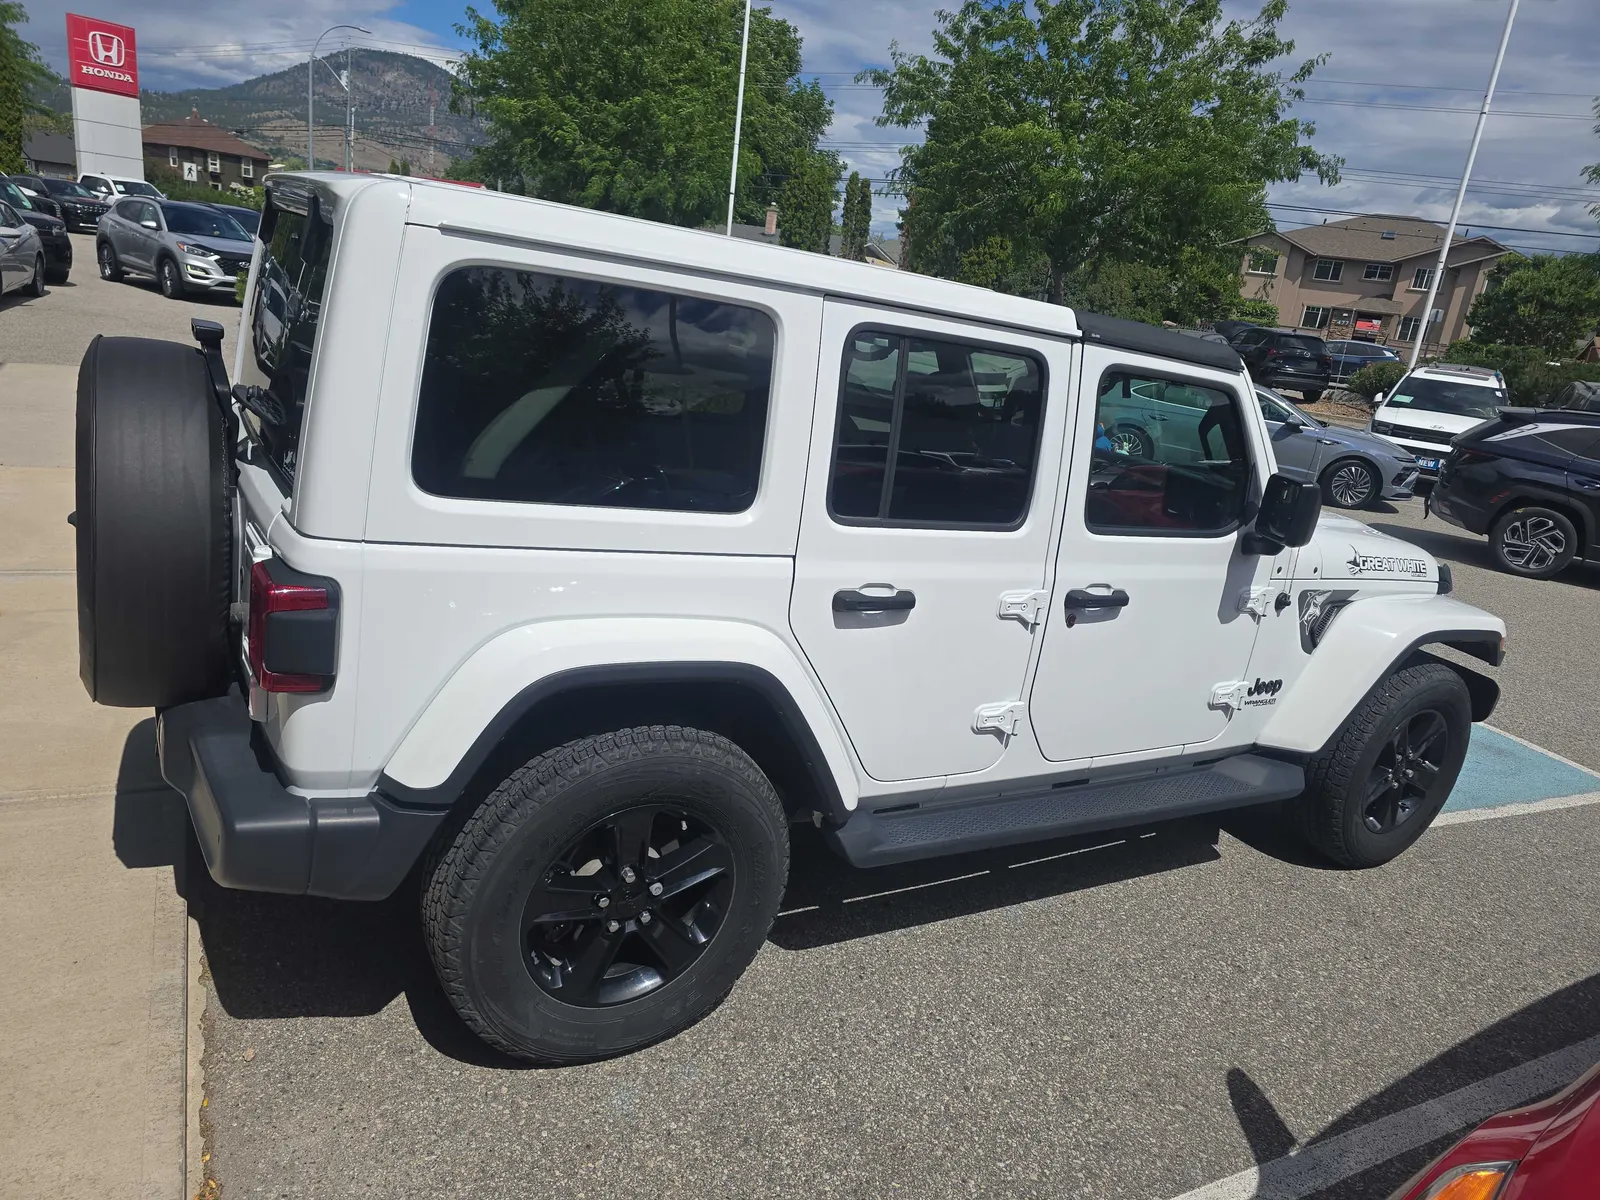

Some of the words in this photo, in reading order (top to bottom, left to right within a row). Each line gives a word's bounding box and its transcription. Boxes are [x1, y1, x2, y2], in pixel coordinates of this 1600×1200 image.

[81, 65, 134, 83] HONDA
[1418, 459, 1435, 468] NEW
[1359, 555, 1395, 571] GREAT
[1395, 557, 1427, 573] WHITE
[1247, 677, 1283, 697] Jeep
